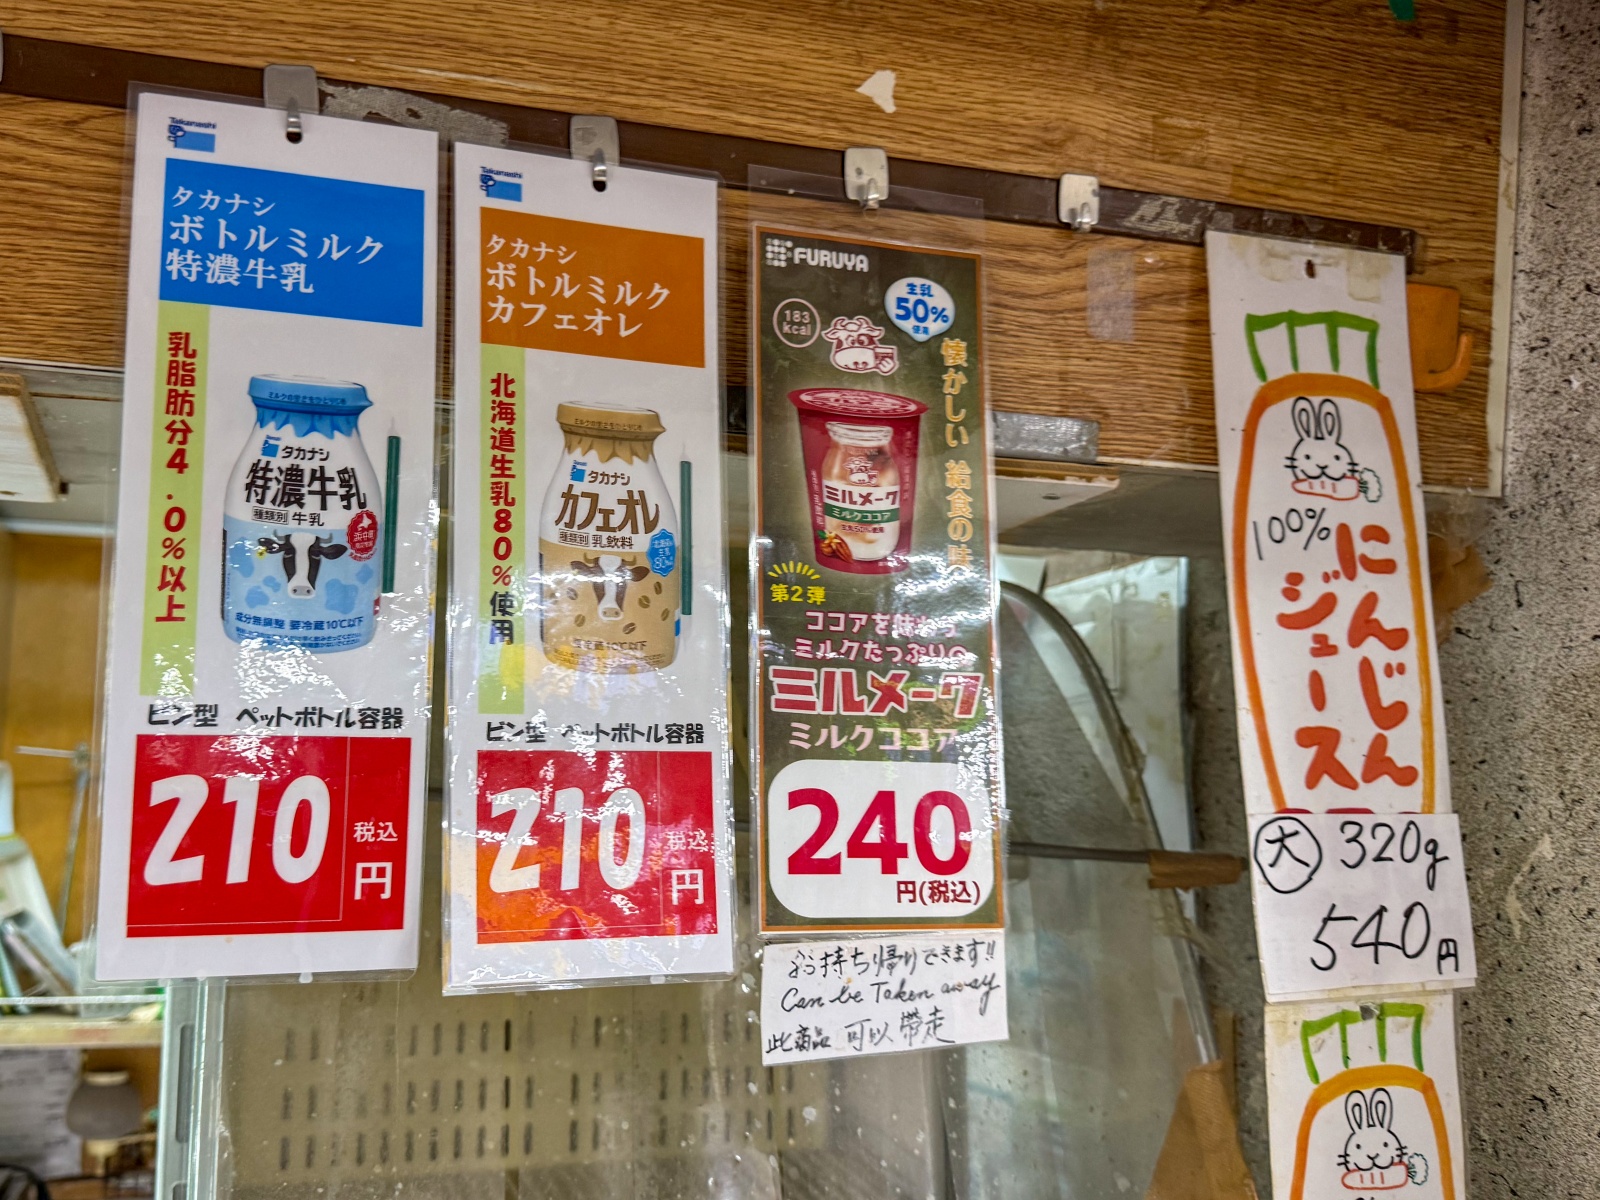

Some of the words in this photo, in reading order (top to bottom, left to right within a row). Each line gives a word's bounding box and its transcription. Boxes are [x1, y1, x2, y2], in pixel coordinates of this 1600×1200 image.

[172, 186, 276, 217] タカナシ
[169, 214, 384, 265] ボトルミルク
[486, 234, 577, 265] タカナシ
[165, 248, 315, 294] 特濃牛乳
[793, 247, 869, 273] FURUYA
[486, 261, 671, 310] ボトルミルク
[487, 295, 643, 338] カフェオレ
[782, 322, 812, 336] kcal
[784, 309, 811, 324] 183
[895, 297, 949, 324] 50%
[281, 445, 330, 462] タカナシ
[245, 459, 367, 511] 特濃牛乳
[588, 470, 631, 486] タカナシ
[825, 484, 899, 506] ミルメーク
[292, 511, 325, 527] 牛乳
[489, 372, 516, 646] 北海道生乳80%使用
[555, 484, 660, 535] カフェオレ
[831, 507, 891, 522] ミルクココア
[1253, 508, 1331, 561] 100%
[770, 584, 827, 605] 第2弾
[1336, 522, 1419, 787] にんじん
[769, 665, 984, 718] ミルメーク
[1276, 569, 1359, 791] ジュース
[148, 704, 218, 728] ビン型
[236, 706, 404, 730] ペットボトル容器
[788, 721, 959, 752] ミルクココア
[143, 774, 331, 887] 210
[353, 821, 398, 843] 税込
[489, 787, 646, 893] 210
[666, 830, 708, 851] 税込
[788, 787, 972, 876] 240
[1340, 820, 1449, 891] 320g
[353, 861, 393, 901] 円
[671, 868, 705, 905] 円
[896, 880, 981, 905] 円(税込)
[781, 987, 824, 1012] Can
[829, 985, 864, 1004] be
[870, 978, 934, 1003] Taken
[941, 972, 1001, 1016] away
